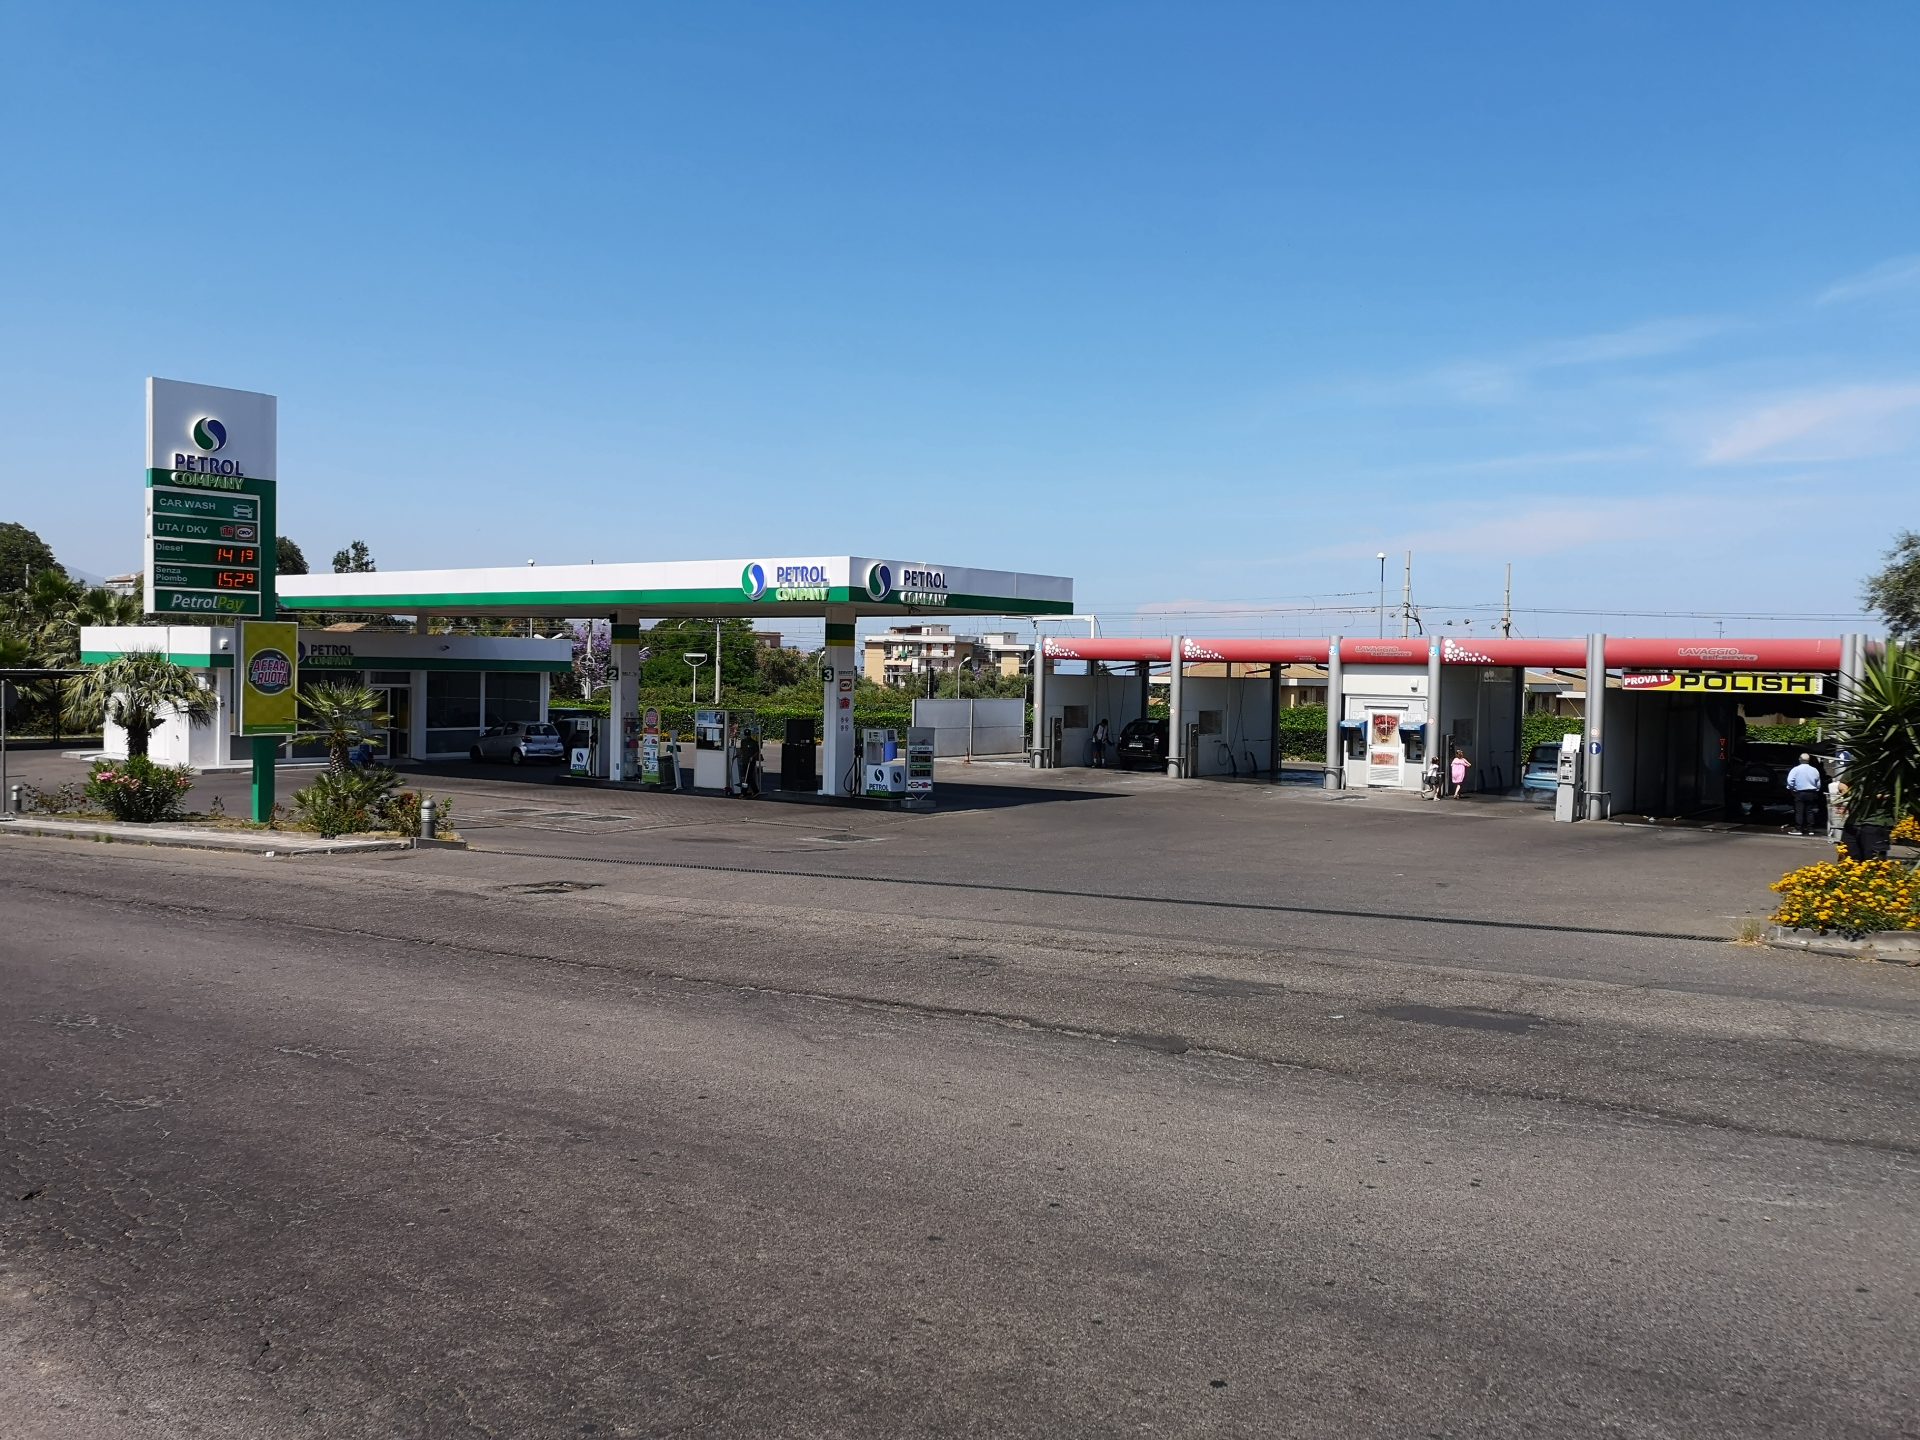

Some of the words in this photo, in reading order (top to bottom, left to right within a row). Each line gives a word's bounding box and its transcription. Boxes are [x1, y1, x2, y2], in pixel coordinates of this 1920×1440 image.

[174, 452, 244, 477] PETROL
[171, 471, 245, 490] COMPANY
[159, 498, 182, 508] CAR
[184, 500, 217, 510] WASH
[157, 522, 177, 532] UTA
[186, 525, 209, 534] DKV
[155, 543, 184, 552] Diesel
[155, 565, 181, 574] Senza
[776, 566, 828, 583] PETROL
[155, 573, 188, 582] Piombo
[903, 569, 949, 589] PETROL
[775, 588, 830, 601] COMPANY
[900, 591, 949, 606] COMPANY
[310, 644, 355, 656] PETROL
[1679, 647, 1739, 656] LAVAGGIO
[252, 659, 290, 673] AFFARI
[256, 670, 289, 685] RUOTA
[608, 669, 617, 680] 2
[823, 669, 833, 681] 3
[1624, 676, 1658, 687] PROVA
[1660, 674, 1671, 684] IL
[1679, 674, 1812, 692] POLISH
